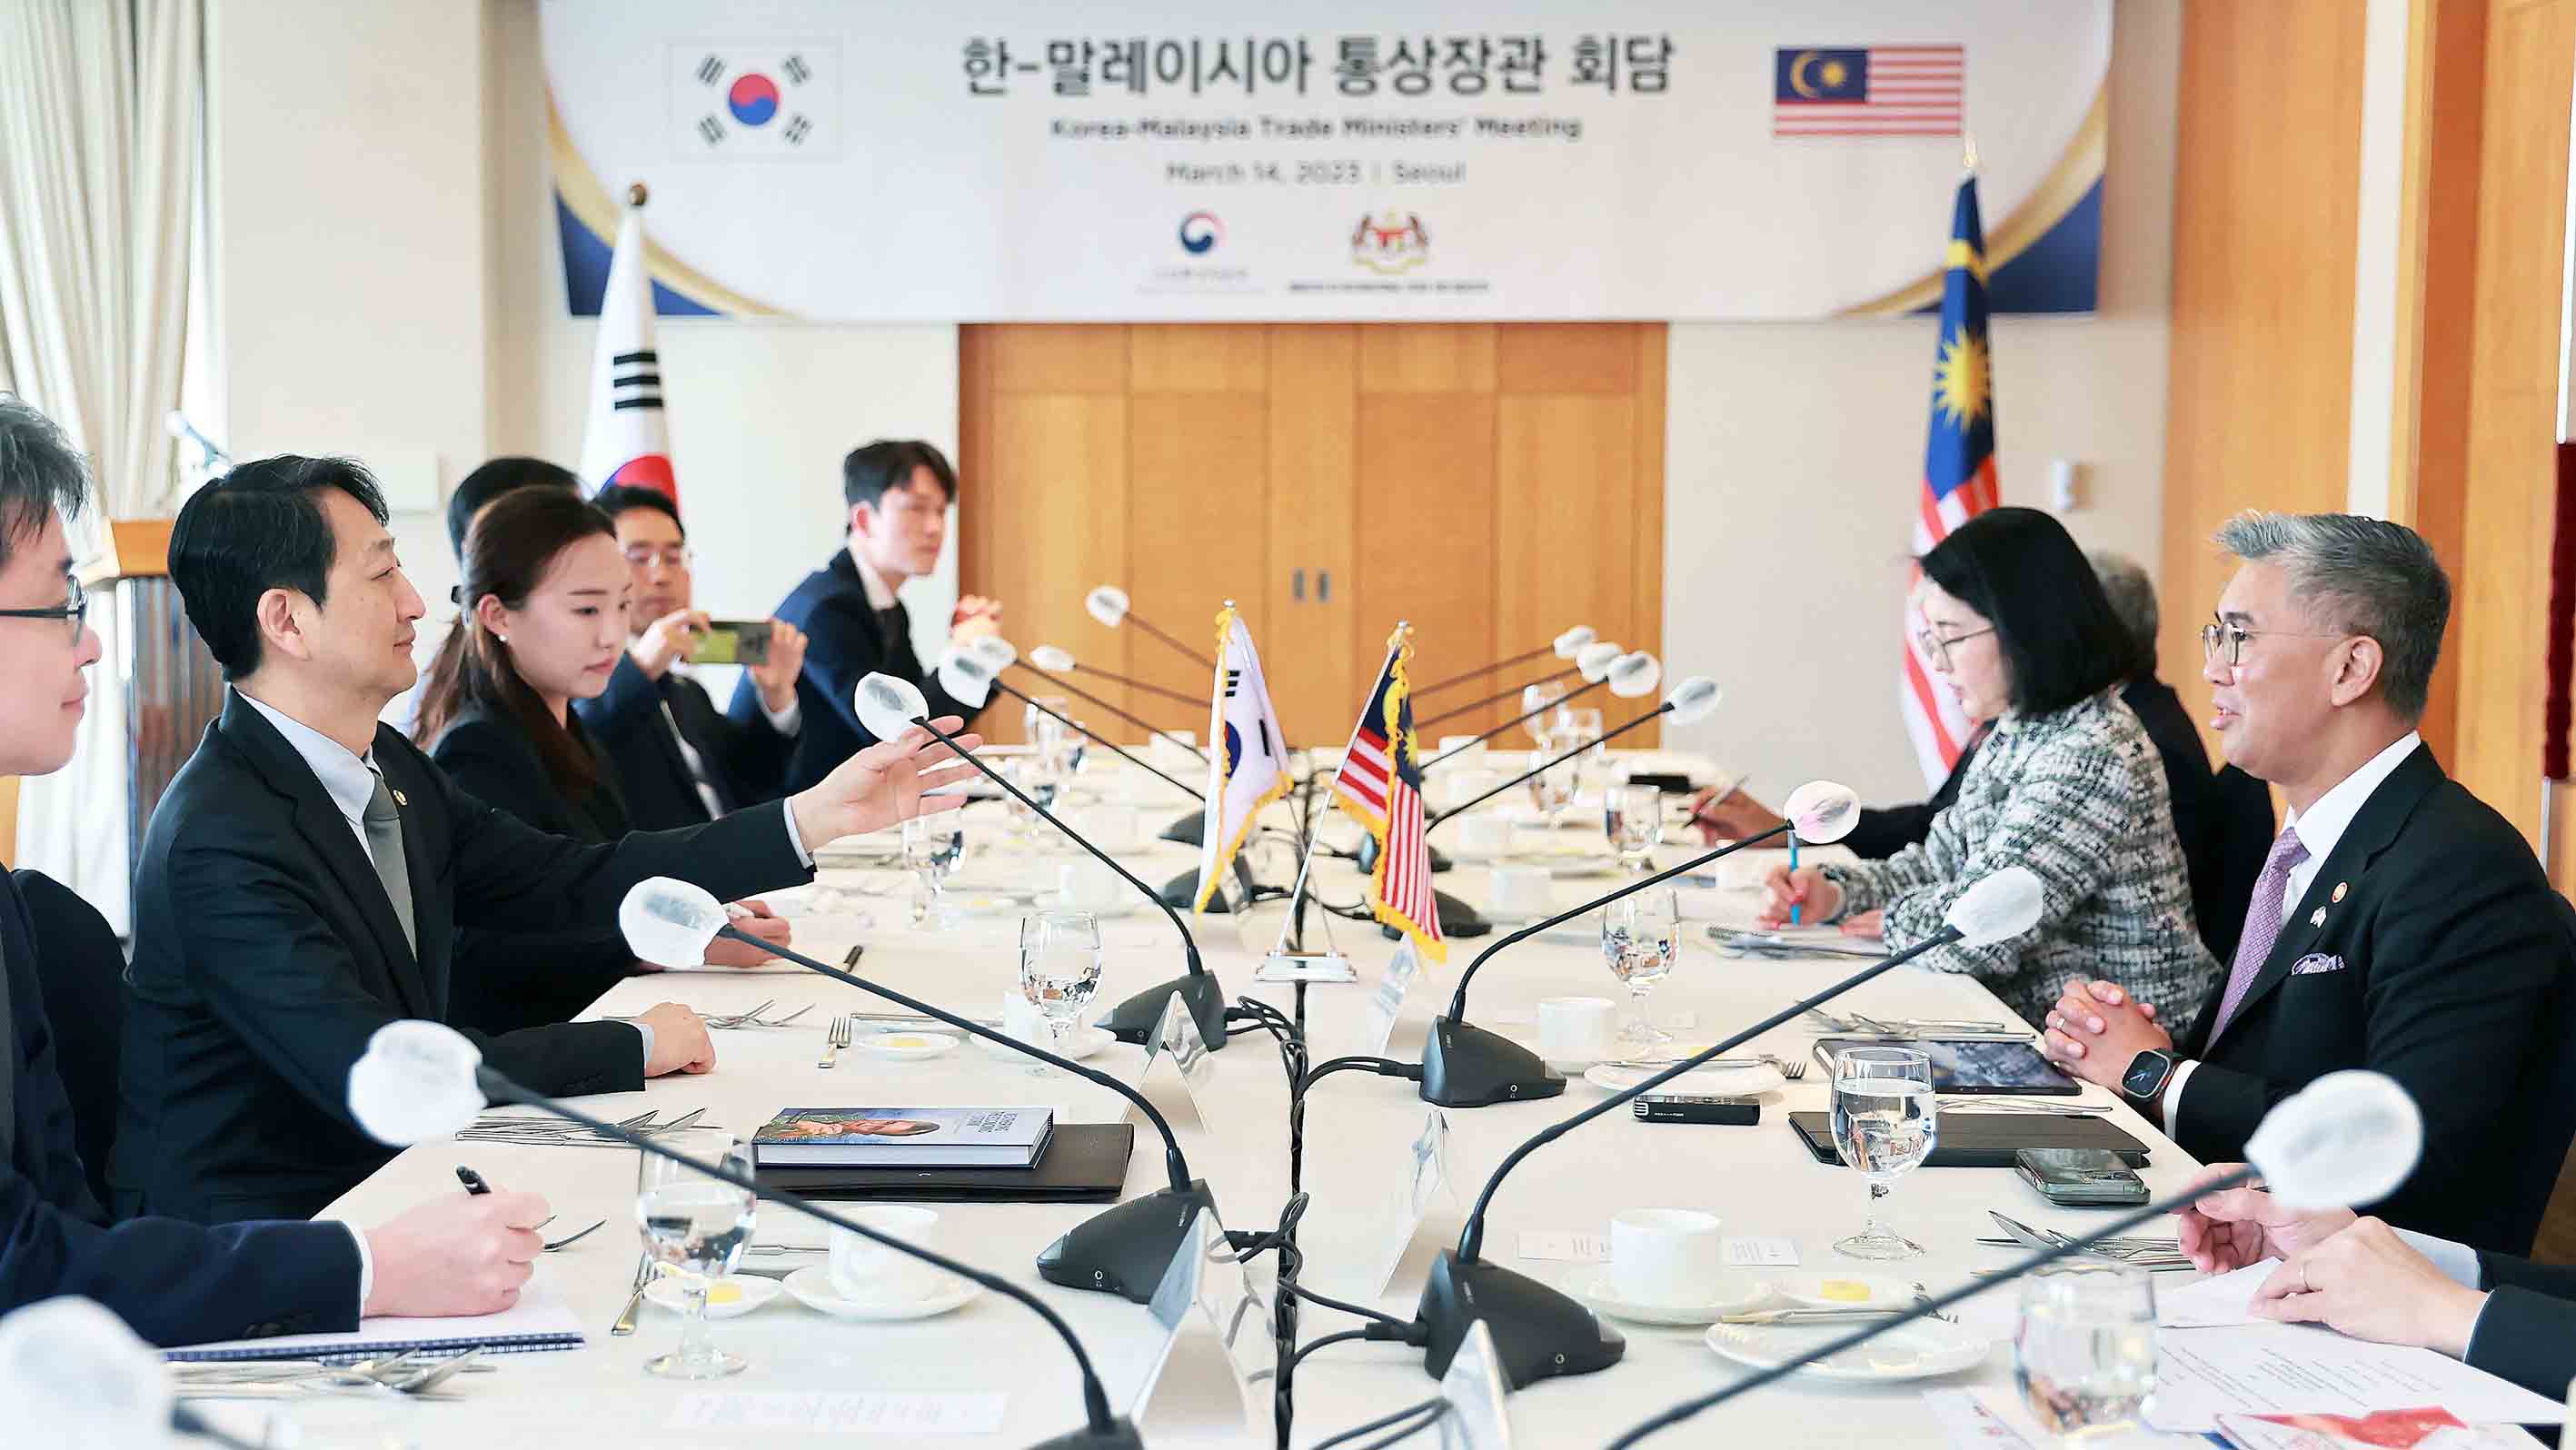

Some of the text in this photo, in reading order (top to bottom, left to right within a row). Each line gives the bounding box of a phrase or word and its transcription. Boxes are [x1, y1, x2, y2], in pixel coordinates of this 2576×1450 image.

[963, 34, 1675, 97] 한-말레이시아 통상장관 회담
[1050, 116, 1249, 141] Korea-Malaysia
[1258, 115, 1334, 138] Trade
[1474, 116, 1581, 142] Meeting
[1166, 160, 1247, 184] March
[1392, 160, 1466, 184] Seoul
